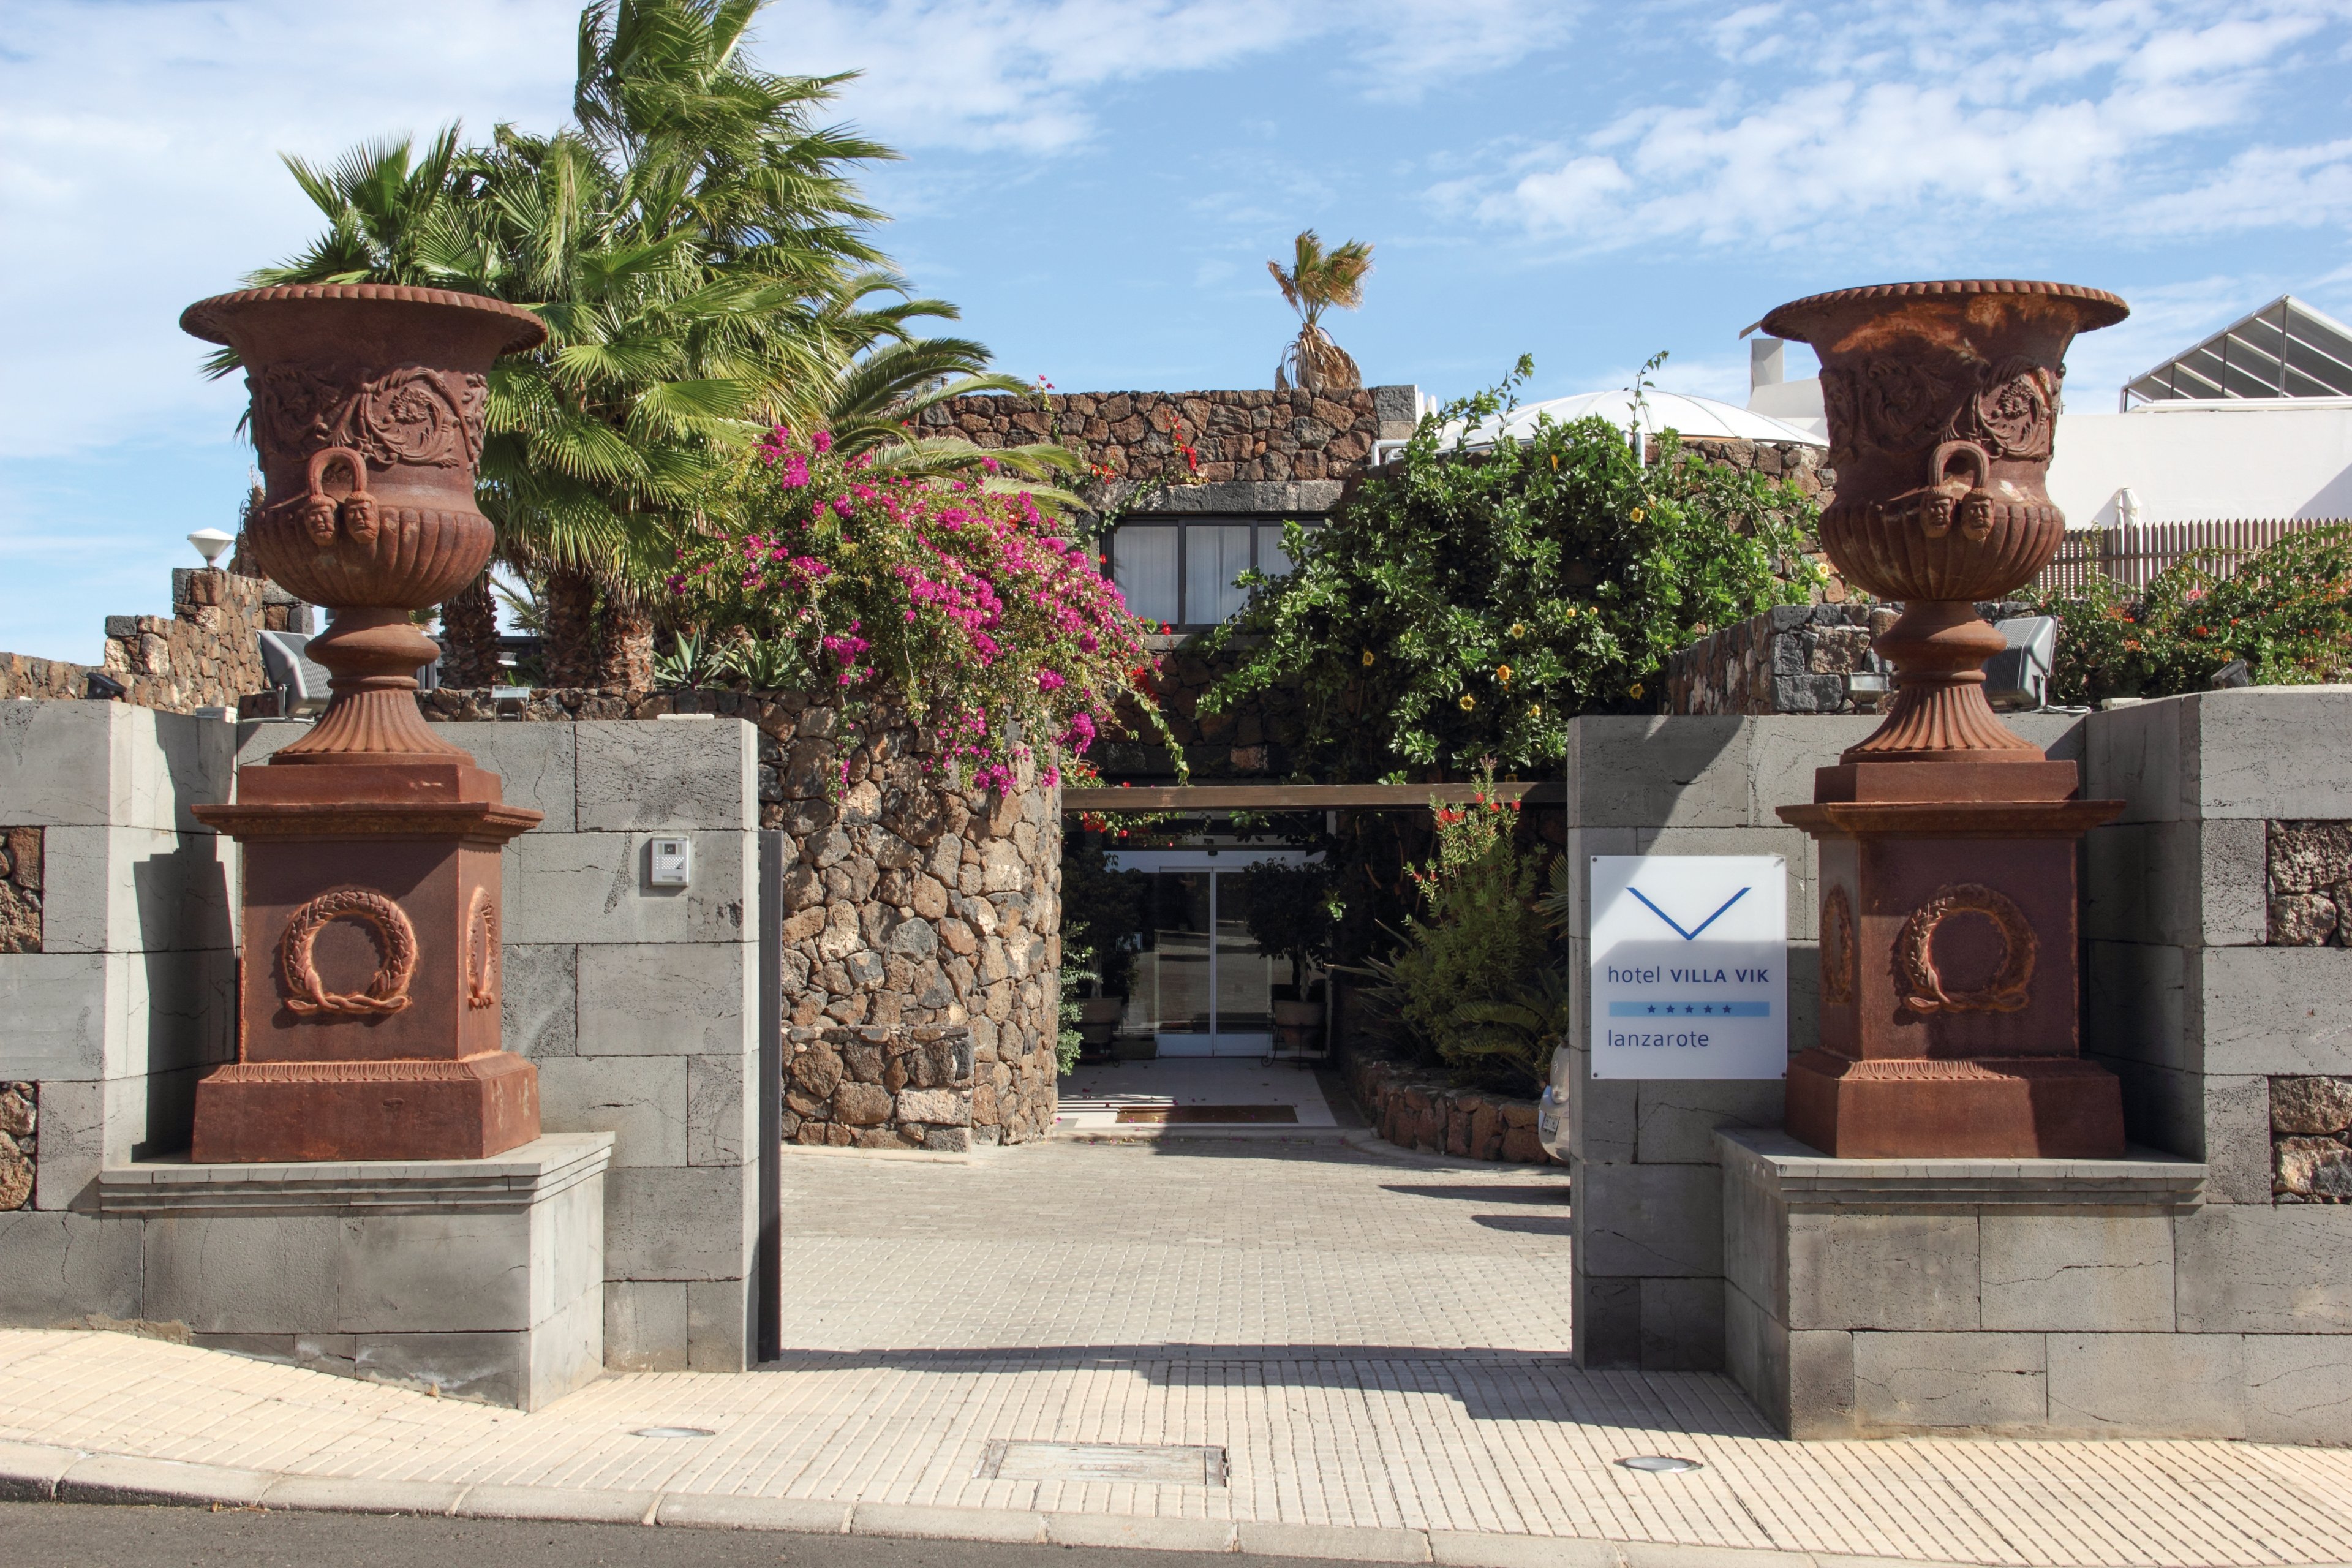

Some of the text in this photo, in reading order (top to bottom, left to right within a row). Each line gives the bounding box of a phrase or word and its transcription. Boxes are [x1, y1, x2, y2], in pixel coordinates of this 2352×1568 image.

[1608, 966, 1770, 984] hotel VILLA VIK
[1608, 1030, 1709, 1047] lanzarote
